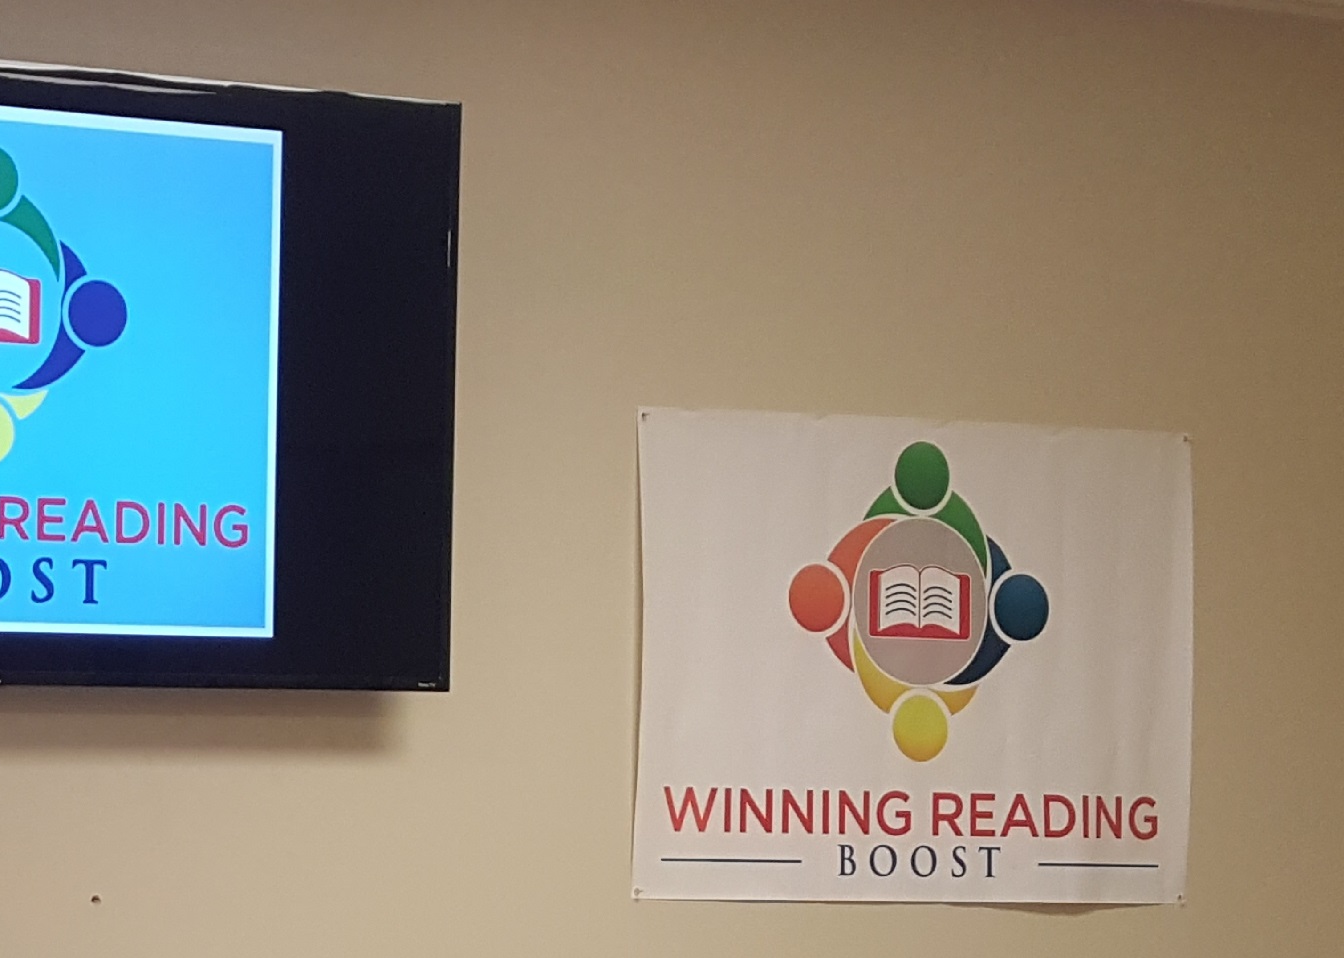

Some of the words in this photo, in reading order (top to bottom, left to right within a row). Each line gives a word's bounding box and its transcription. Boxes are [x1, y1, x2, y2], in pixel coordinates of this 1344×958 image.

[663, 785, 912, 836] WINNING
[931, 792, 1159, 840] READING
[837, 844, 1002, 878] BOOST
